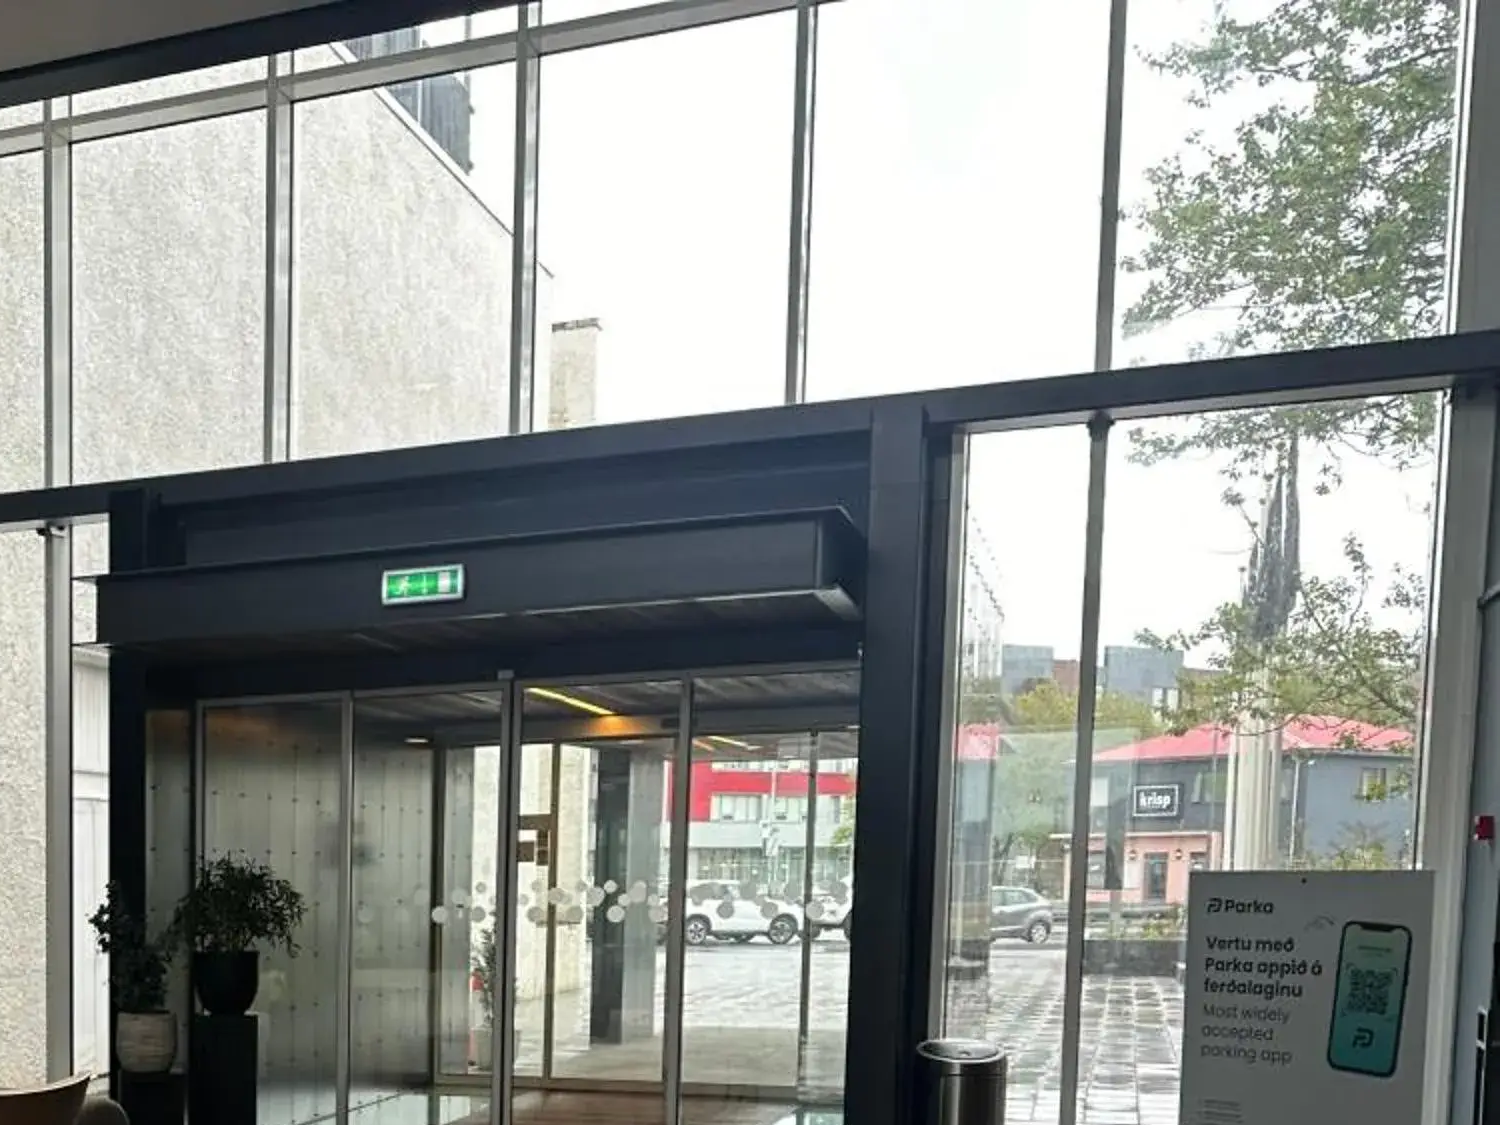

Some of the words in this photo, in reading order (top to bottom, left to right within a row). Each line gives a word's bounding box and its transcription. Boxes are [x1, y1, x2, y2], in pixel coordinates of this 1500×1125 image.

[1225, 899, 1275, 914] Parka
[1206, 936, 1251, 951] Vertu
[1205, 957, 1253, 973] Parka
[1257, 959, 1308, 978] appið
[1204, 978, 1303, 999] ferðalaginu
[1203, 1003, 1238, 1019] Most
[1242, 1006, 1290, 1024] widely
[1201, 1024, 1274, 1042] accepted
[1200, 1044, 1257, 1064] parking
[1261, 1050, 1293, 1066] app
